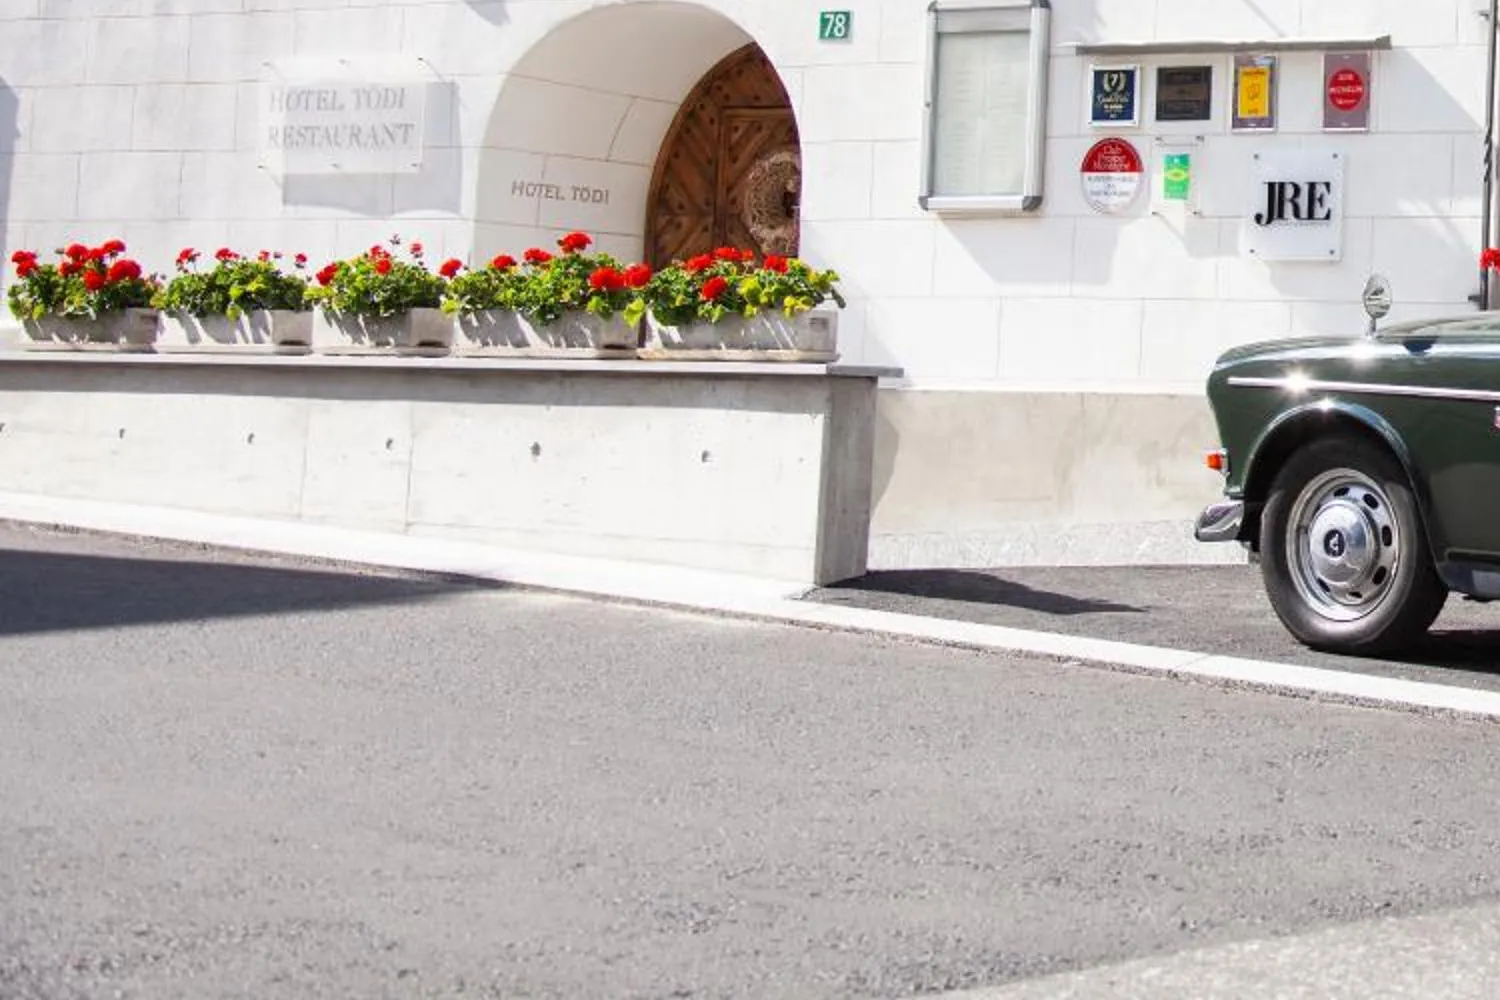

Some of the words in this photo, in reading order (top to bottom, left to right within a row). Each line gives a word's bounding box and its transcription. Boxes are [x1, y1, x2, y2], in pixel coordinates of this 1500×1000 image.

[823, 13, 846, 38] 78
[269, 86, 346, 113] HOTEL
[268, 122, 416, 150] RESTAURANT
[512, 179, 565, 201] HOTEL
[1254, 181, 1331, 226] JRE
